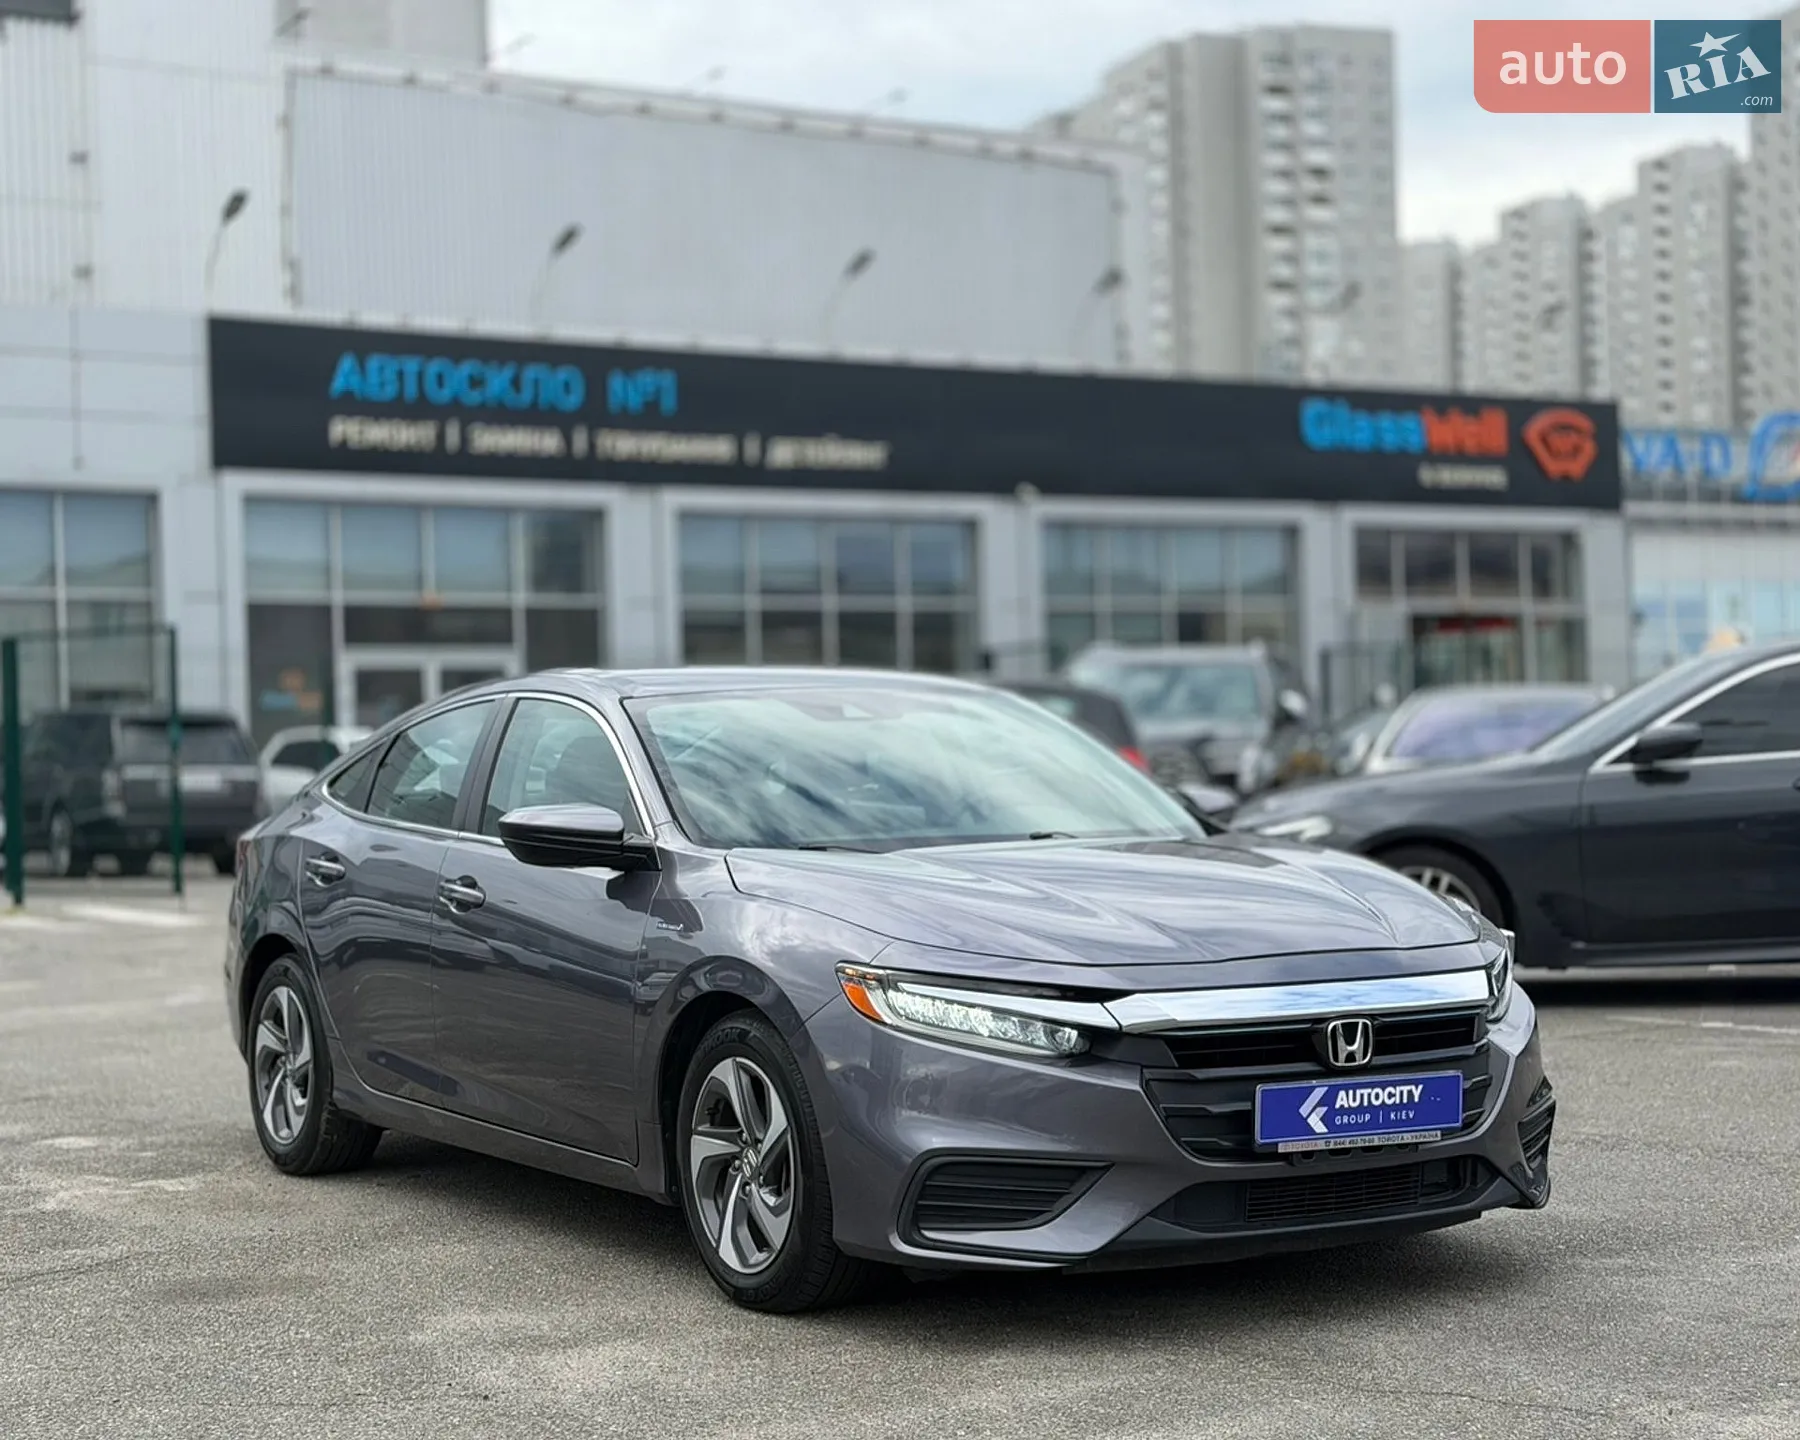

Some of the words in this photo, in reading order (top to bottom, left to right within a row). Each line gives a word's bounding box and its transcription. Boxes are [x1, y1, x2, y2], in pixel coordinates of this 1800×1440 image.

[329, 351, 586, 412] АВТОСКЛО
[1335, 1084, 1424, 1109] AUTOCITY
[1335, 1113, 1371, 1126] GROUP
[1390, 1110, 1415, 1121] KIEV
